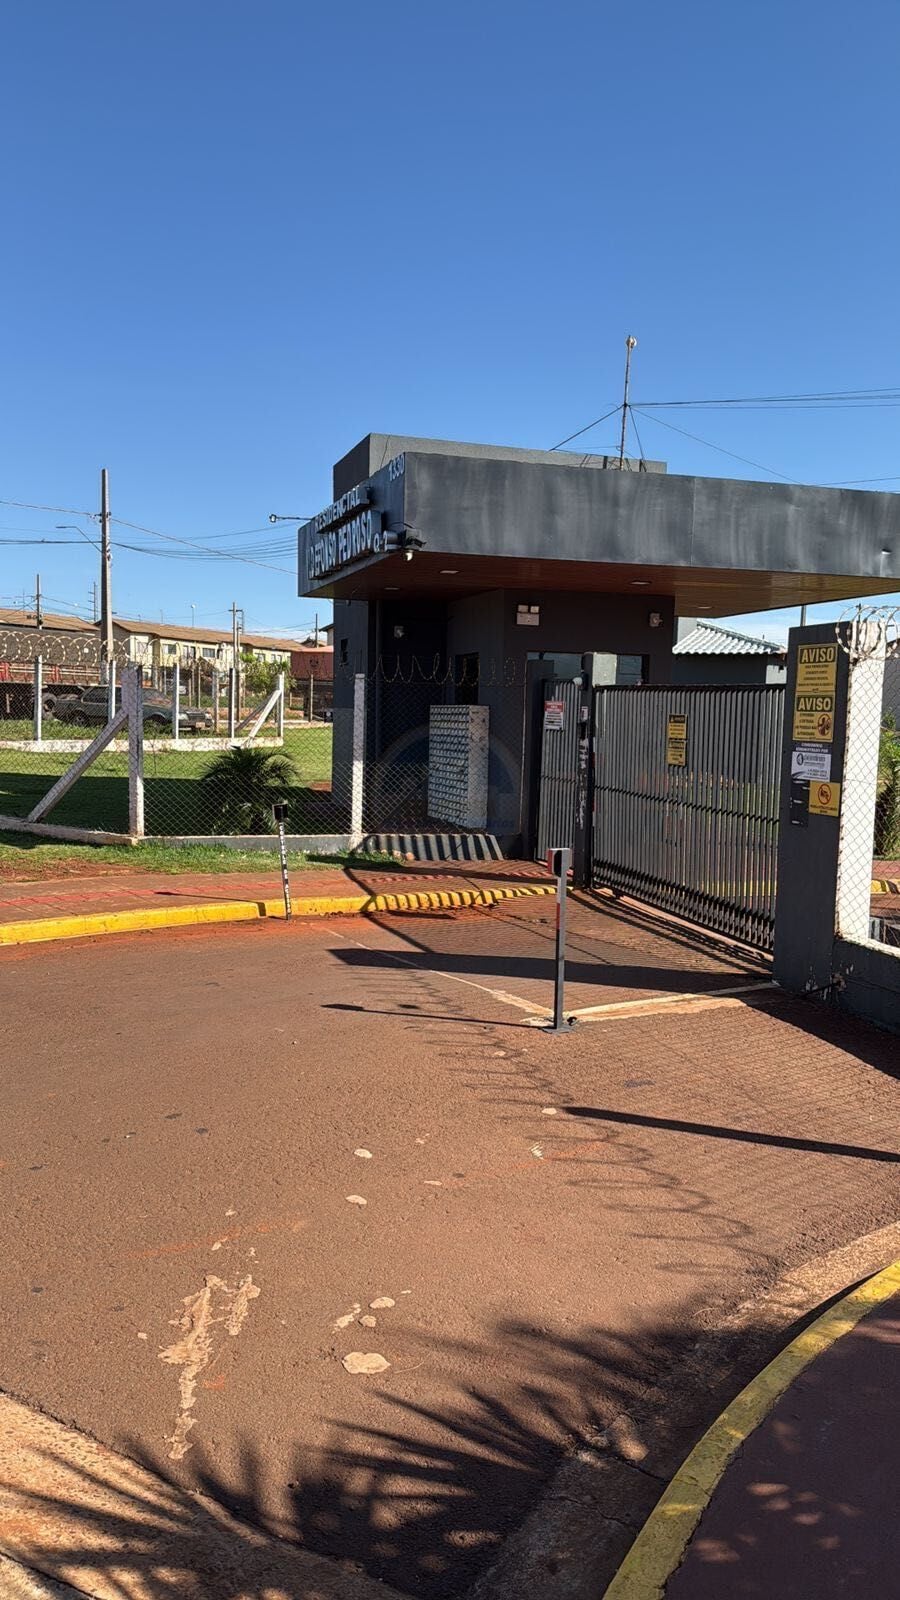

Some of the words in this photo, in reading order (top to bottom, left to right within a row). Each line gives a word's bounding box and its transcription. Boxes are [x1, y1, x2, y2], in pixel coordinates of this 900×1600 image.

[388, 454, 404, 481] 1330
[314, 484, 360, 532] RESIDENCIAL
[338, 510, 372, 564] PEDROSO
[801, 647, 835, 663] AVISO
[798, 697, 831, 711] AVISO
